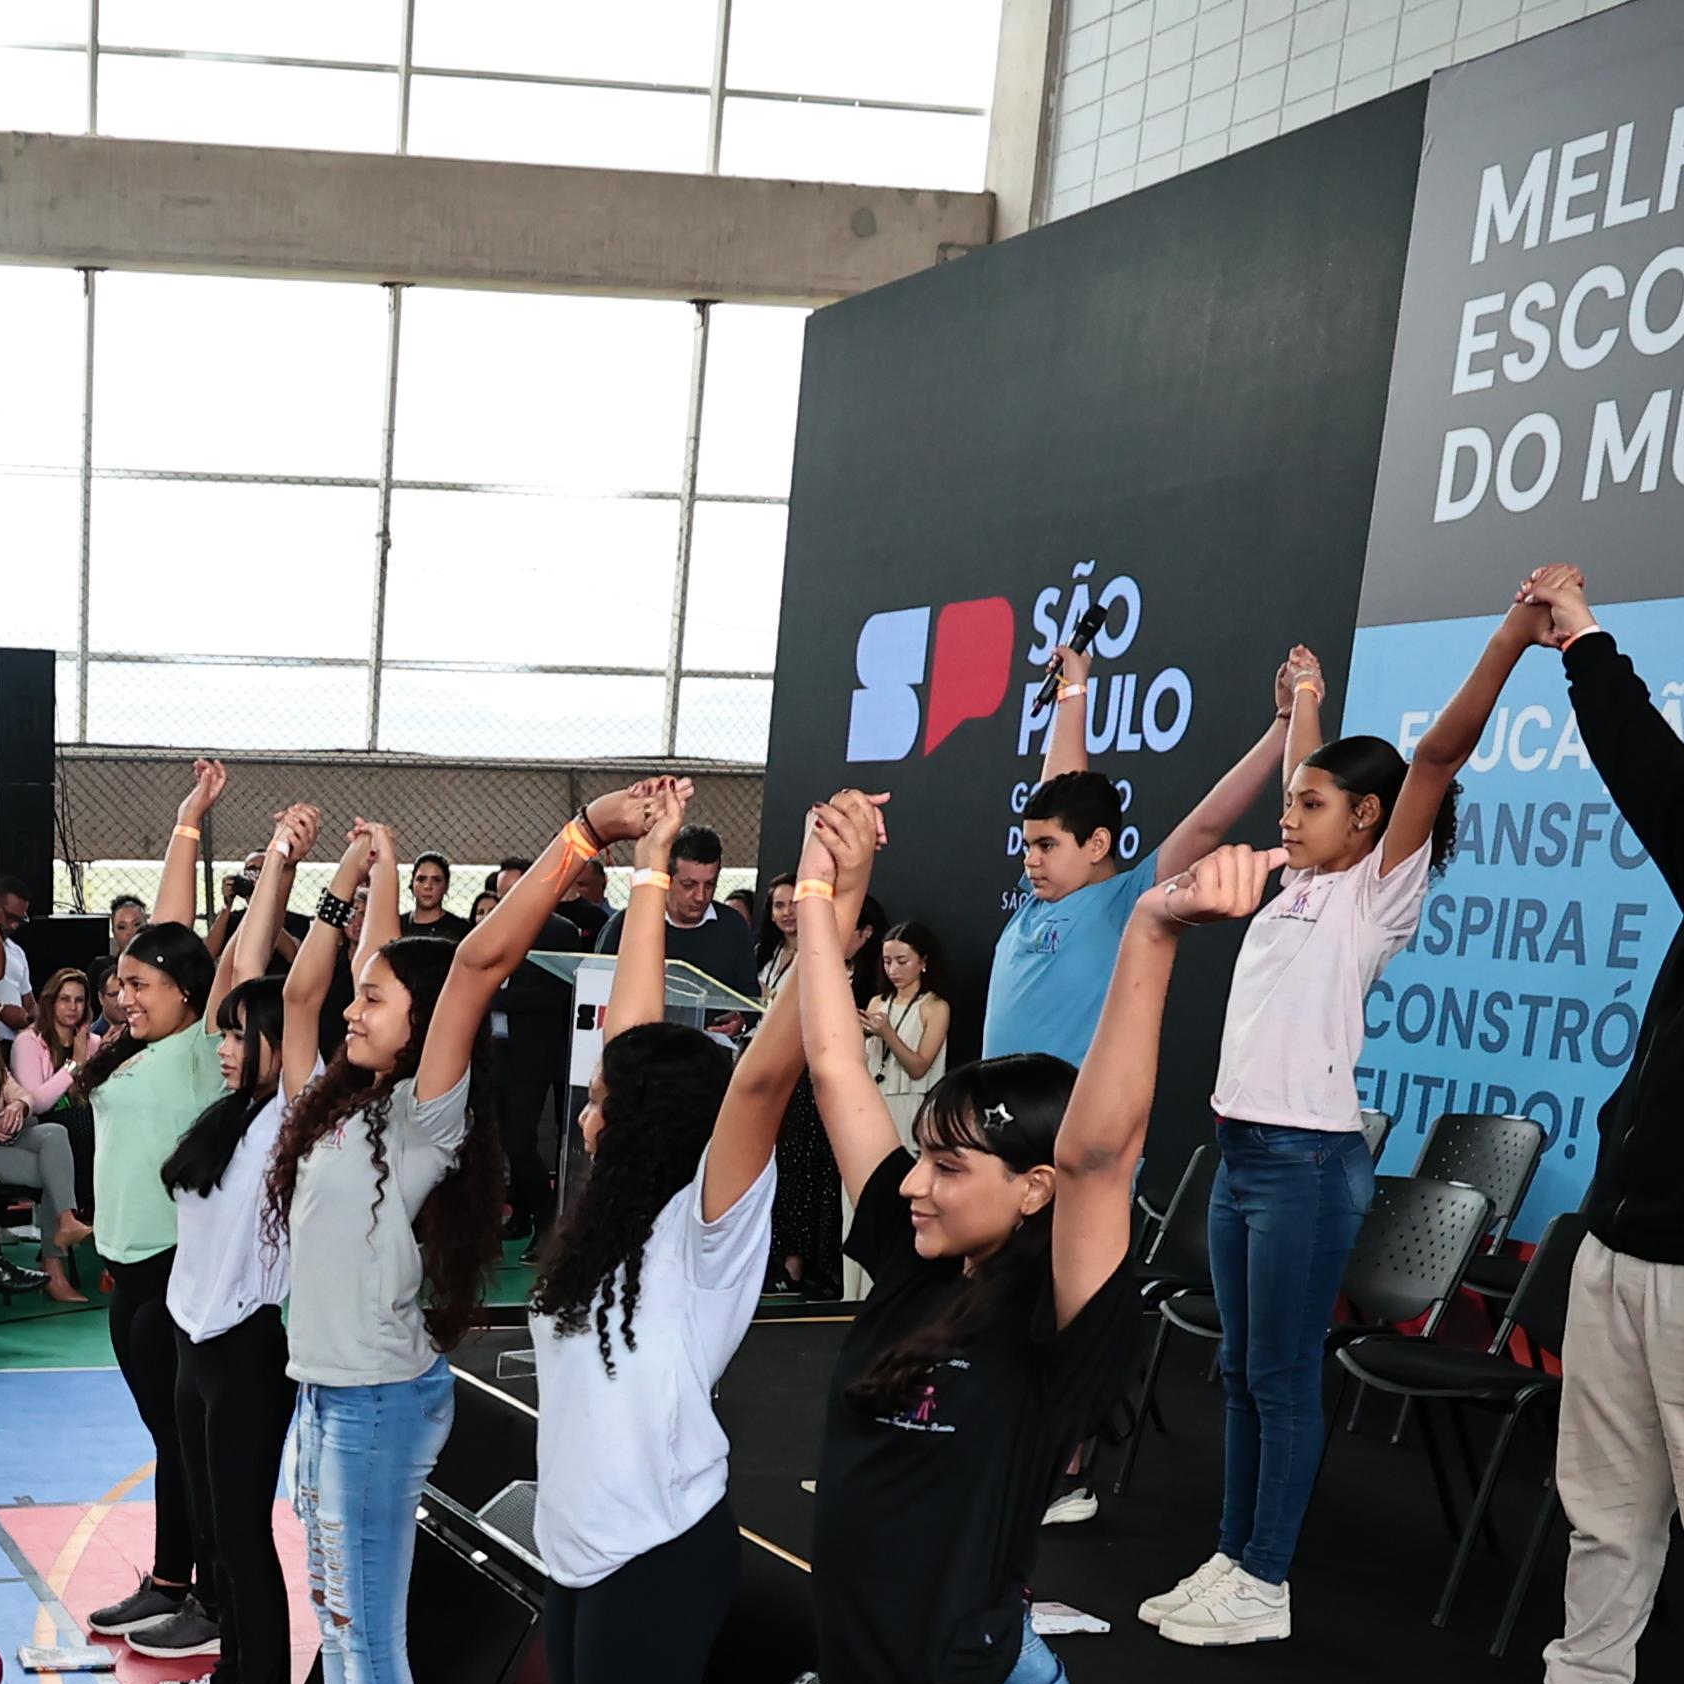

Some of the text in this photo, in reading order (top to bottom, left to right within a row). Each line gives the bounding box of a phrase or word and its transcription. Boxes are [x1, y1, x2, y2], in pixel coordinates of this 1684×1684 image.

[1451, 246, 1684, 396] ESCO
[1433, 387, 1684, 523] DO M
[1027, 559, 1142, 666] SÃO
[1017, 667, 1193, 757] PULO
[1448, 802, 1651, 870] ANSFO
[1407, 894, 1648, 970] SPIRA E
[1363, 980, 1639, 1068] CONSTRÓ
